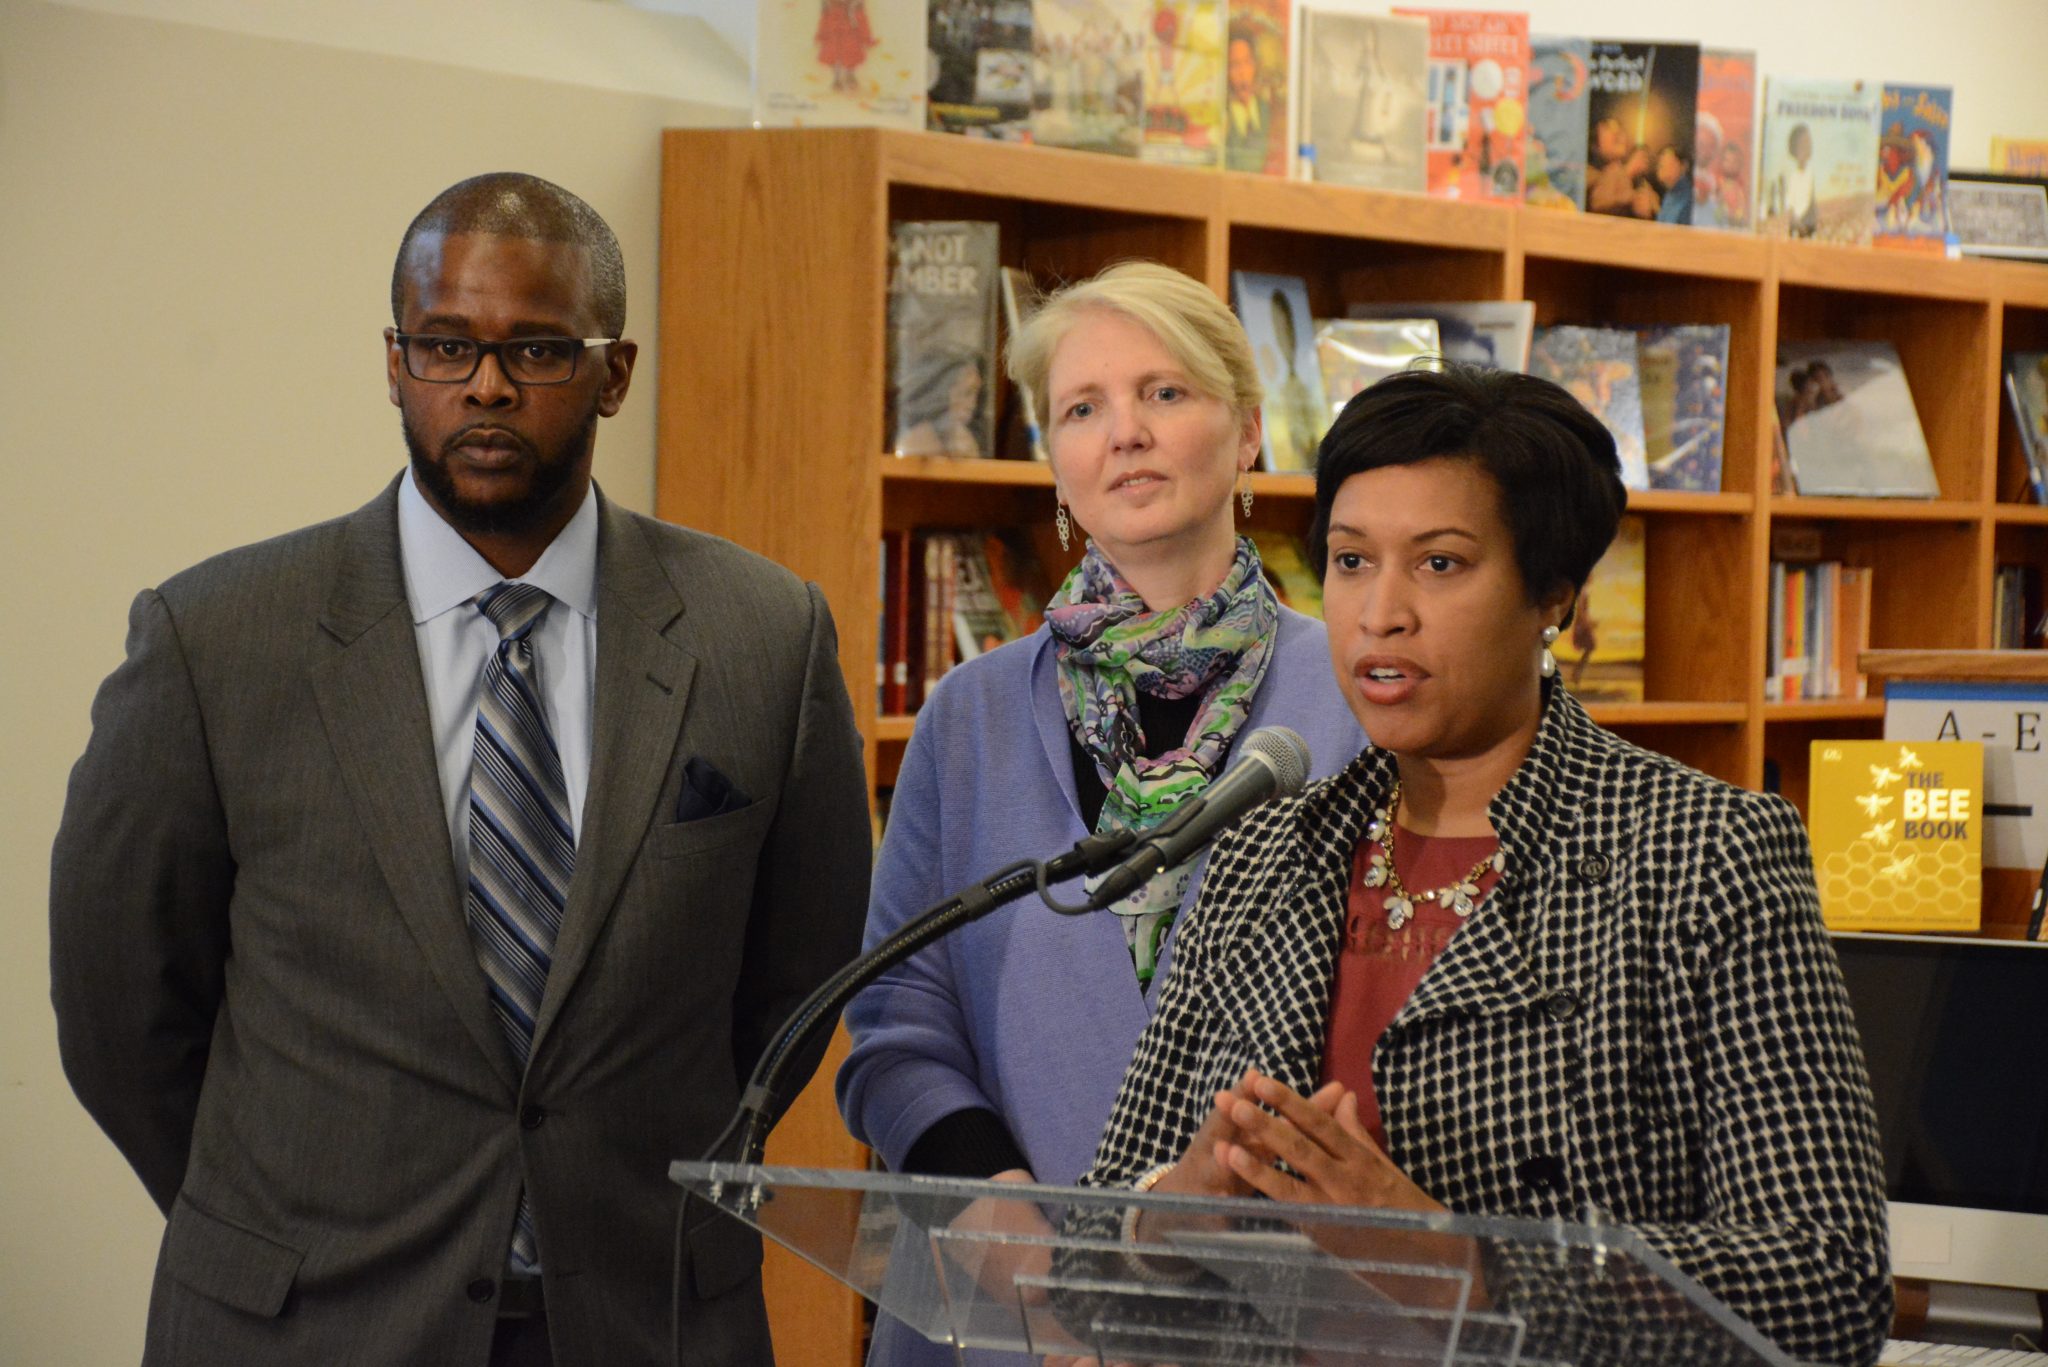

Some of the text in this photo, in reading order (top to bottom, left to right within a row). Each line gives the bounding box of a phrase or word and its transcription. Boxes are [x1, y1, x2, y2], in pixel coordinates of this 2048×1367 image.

[911, 234, 969, 262] NOT
[1937, 710, 1962, 741] A
[2015, 712, 2041, 752] E
[1907, 771, 1944, 788] THE
[1903, 788, 1971, 821] BEE
[1904, 821, 1968, 840] BOOK
